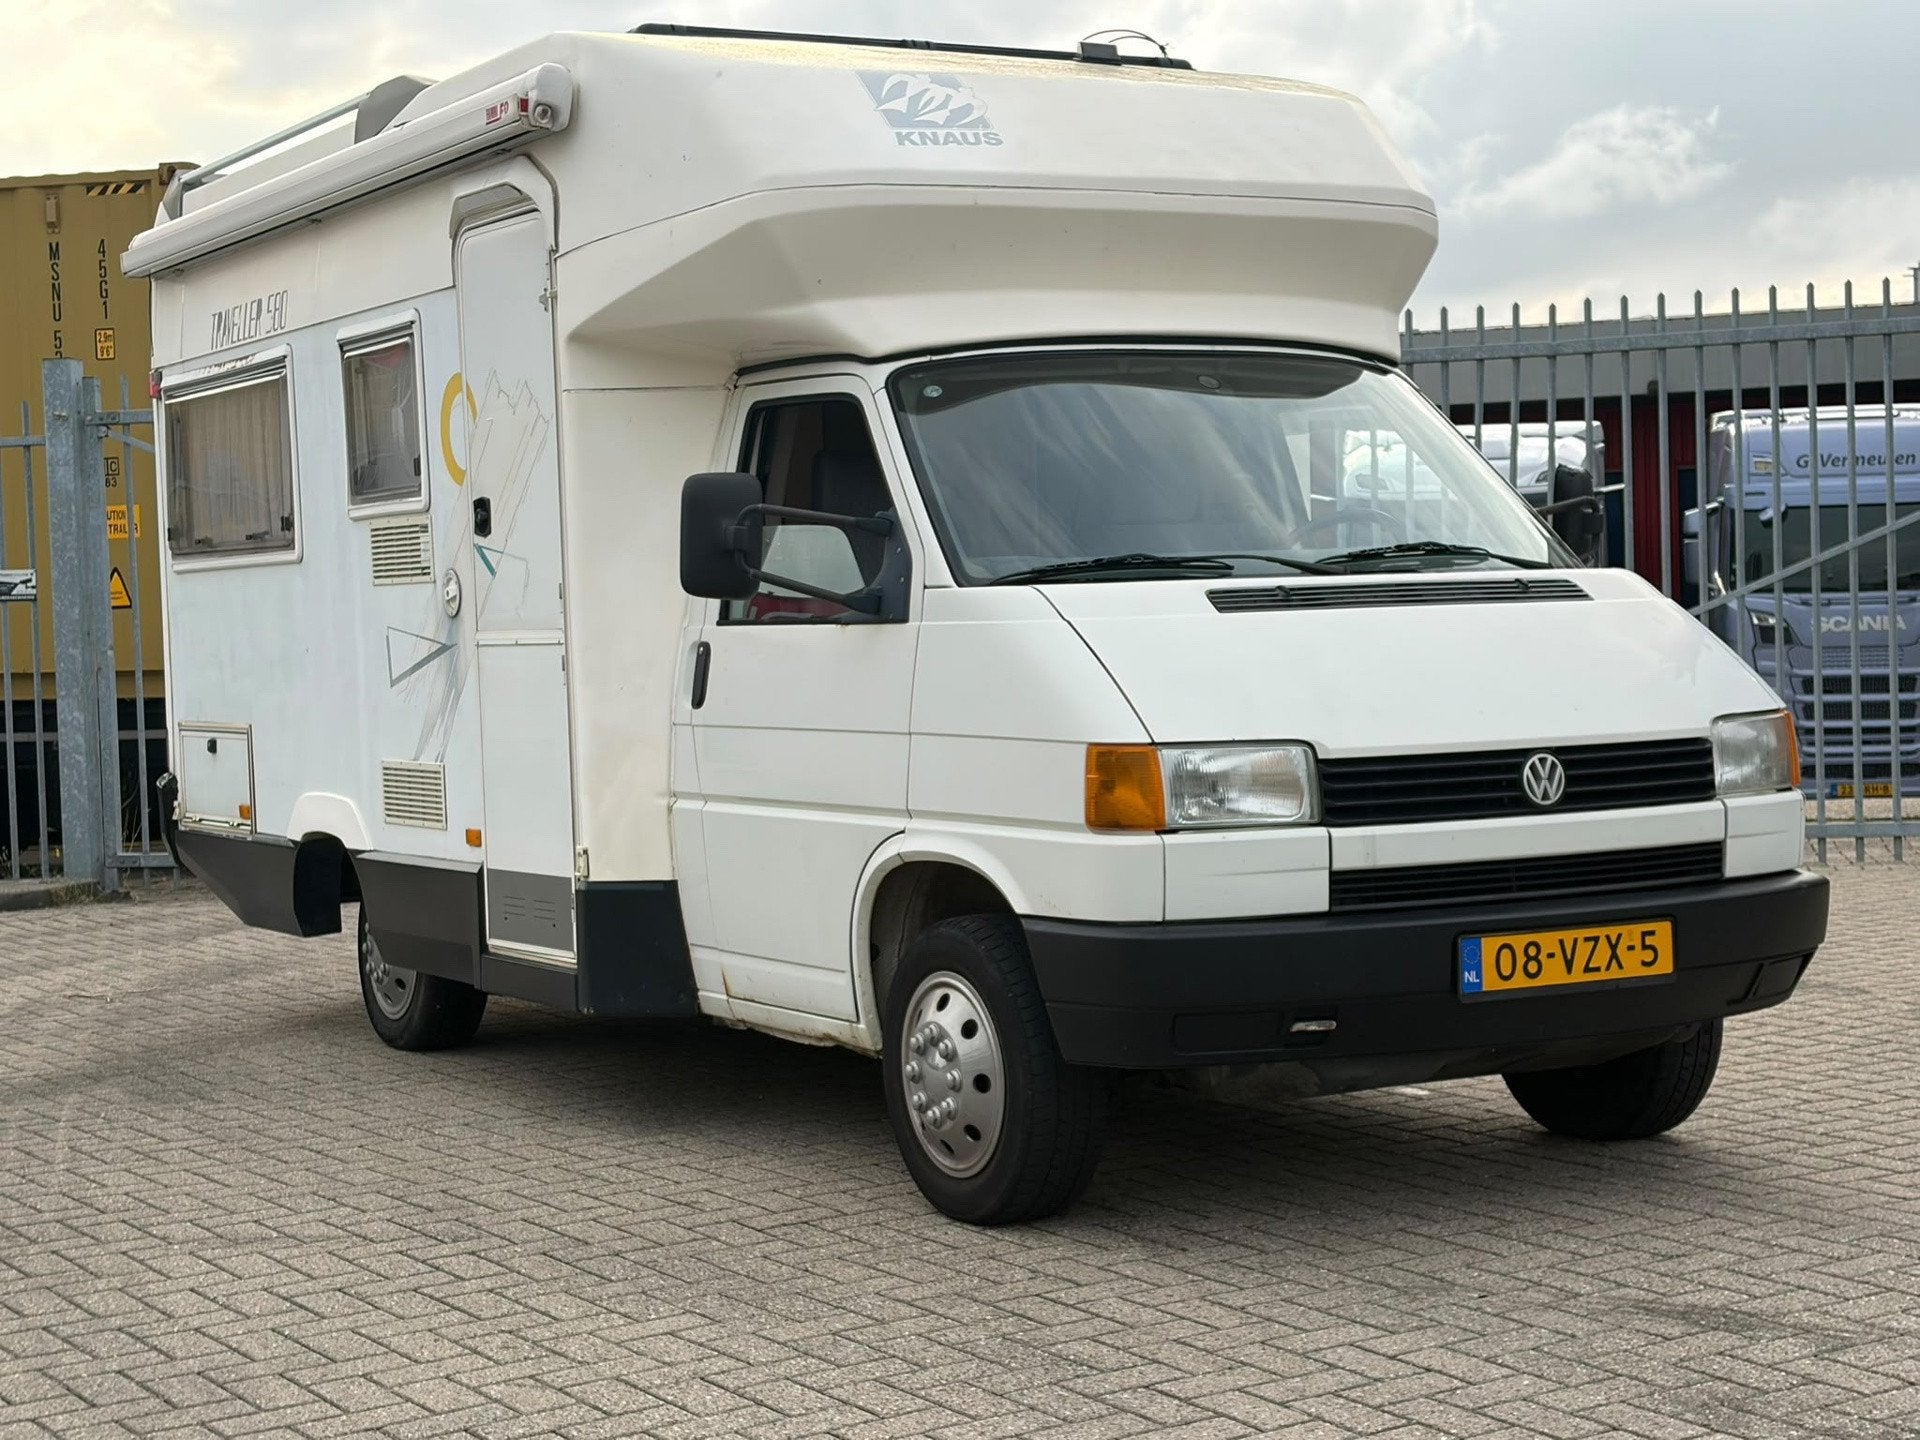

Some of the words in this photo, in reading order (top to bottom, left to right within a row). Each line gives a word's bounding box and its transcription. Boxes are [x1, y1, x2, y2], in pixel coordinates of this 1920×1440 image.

[895, 131, 1004, 146] KNAUS
[49, 242, 62, 322] MSNU
[97, 239, 109, 319] 45G1
[211, 297, 263, 351] TRAVELLER
[1820, 453, 1916, 467] Vermeuen
[1464, 970, 1480, 983] NL
[1494, 929, 1660, 982] 08-VZX-5
